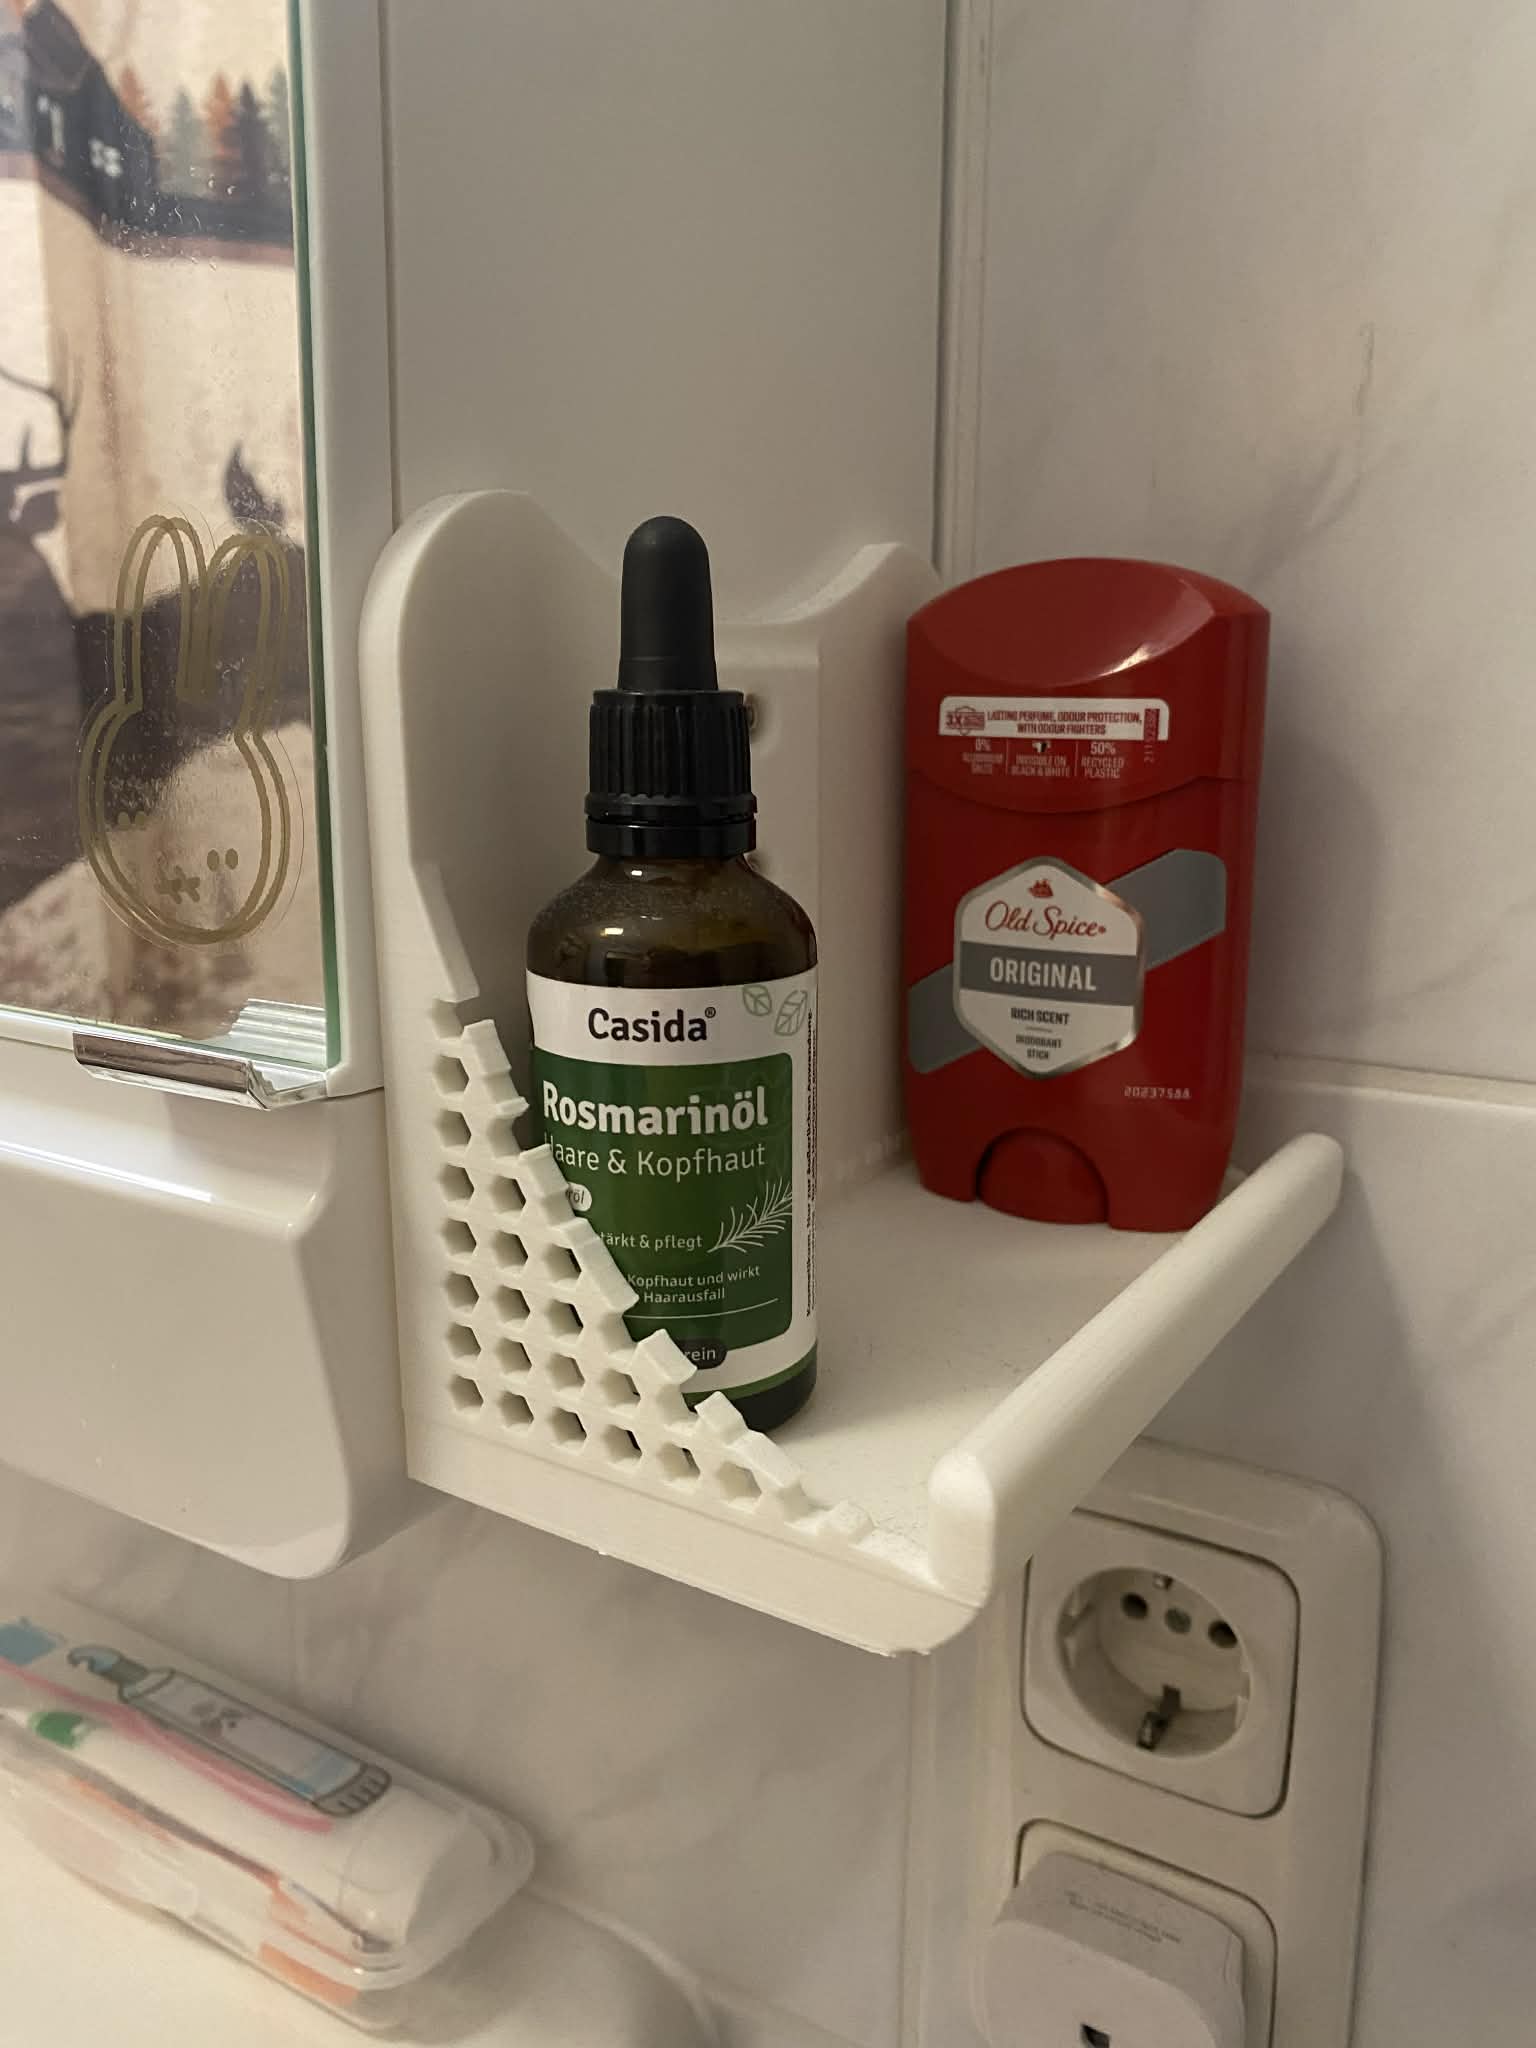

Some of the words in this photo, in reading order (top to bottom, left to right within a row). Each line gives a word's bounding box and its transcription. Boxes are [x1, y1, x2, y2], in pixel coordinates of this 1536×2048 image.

[1017, 723, 1037, 734] WITH
[1090, 741, 1116, 755] 50%
[984, 900, 1033, 933] Old
[989, 956, 1098, 992] ORIGINAL
[1010, 1006, 1036, 1022] RICH
[1036, 1009, 1070, 1025] SCENT
[1026, 1048, 1050, 1060] STICK
[543, 1079, 768, 1136] Rosmarinöl
[606, 1148, 627, 1174] &
[637, 1143, 765, 1182] Kopfhaut
[639, 1233, 650, 1249] &
[655, 1234, 703, 1257] pflegt
[626, 1273, 694, 1290] Kopfhaut
[697, 1270, 724, 1286] und
[727, 1264, 760, 1283] wirkt
[643, 1287, 726, 1304] Haarausfall
